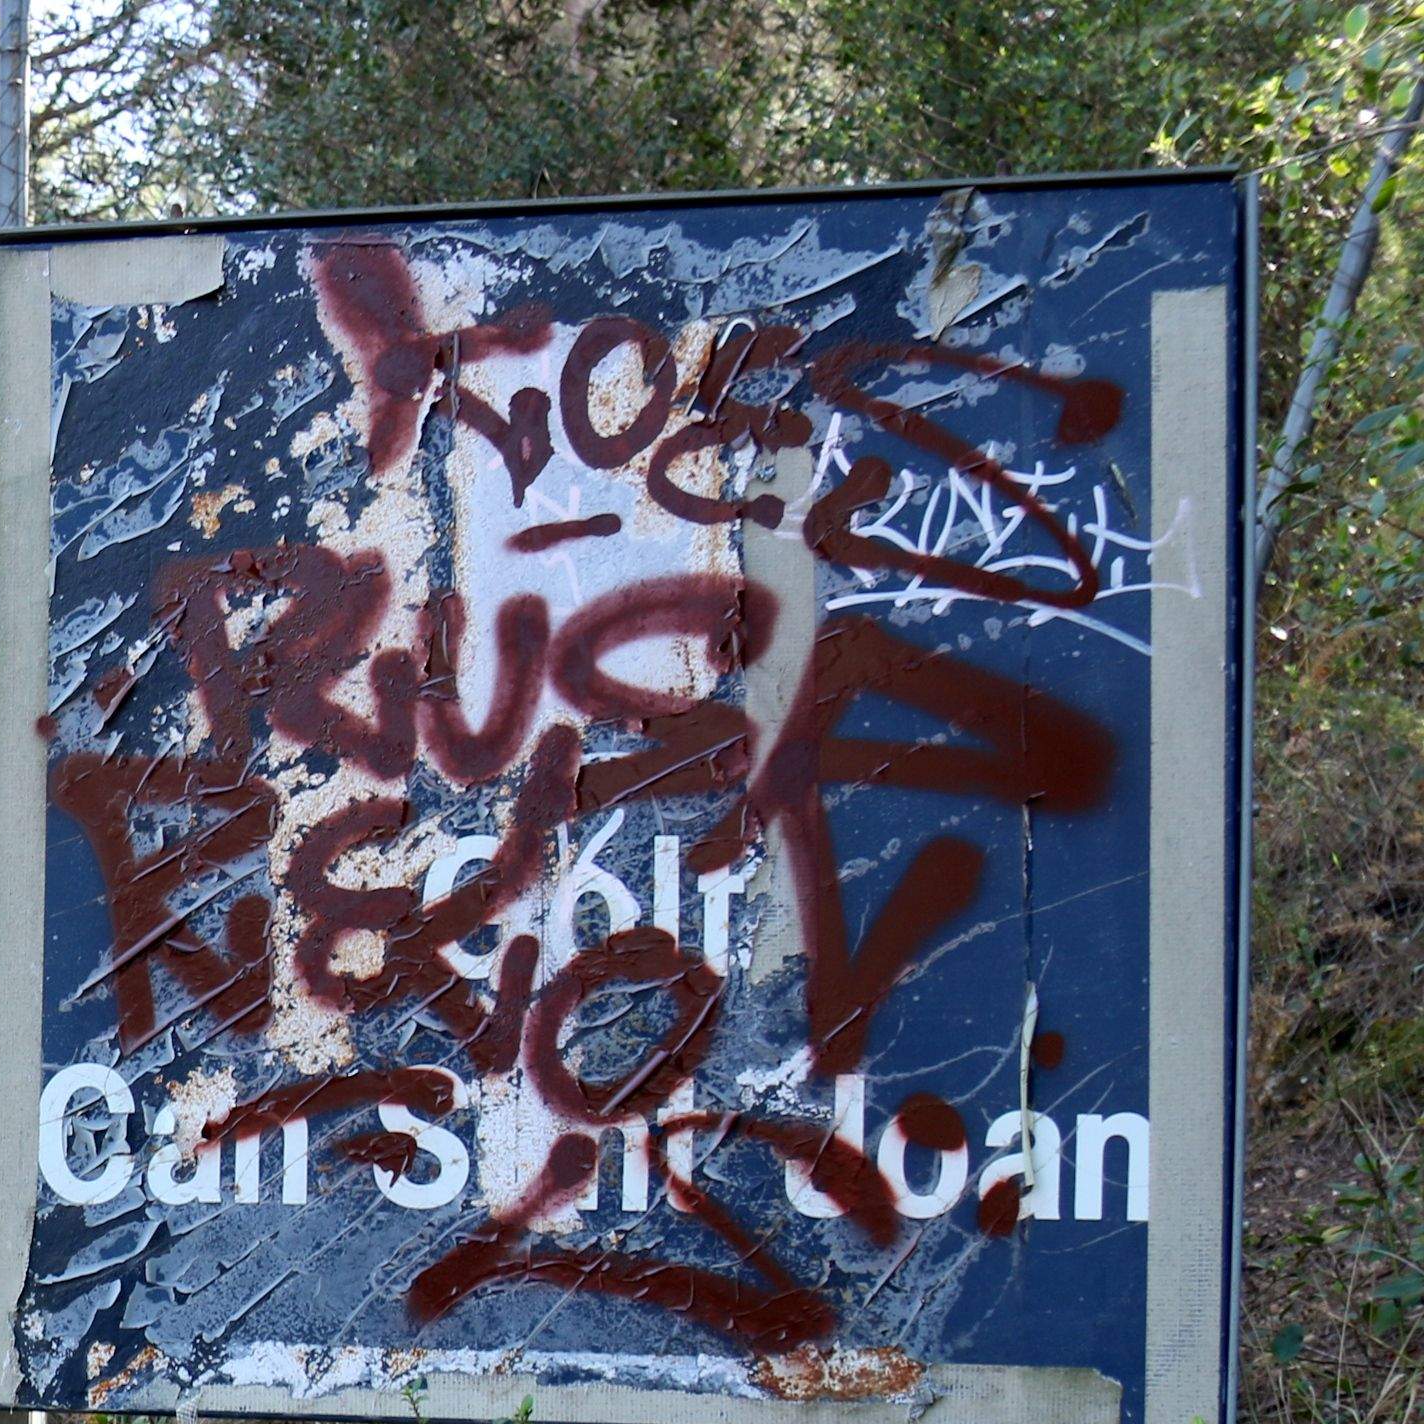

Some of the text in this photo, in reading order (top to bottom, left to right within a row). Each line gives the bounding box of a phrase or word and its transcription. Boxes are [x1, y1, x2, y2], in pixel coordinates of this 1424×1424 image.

[39, 1062, 1150, 1220] Can Snt Joan
